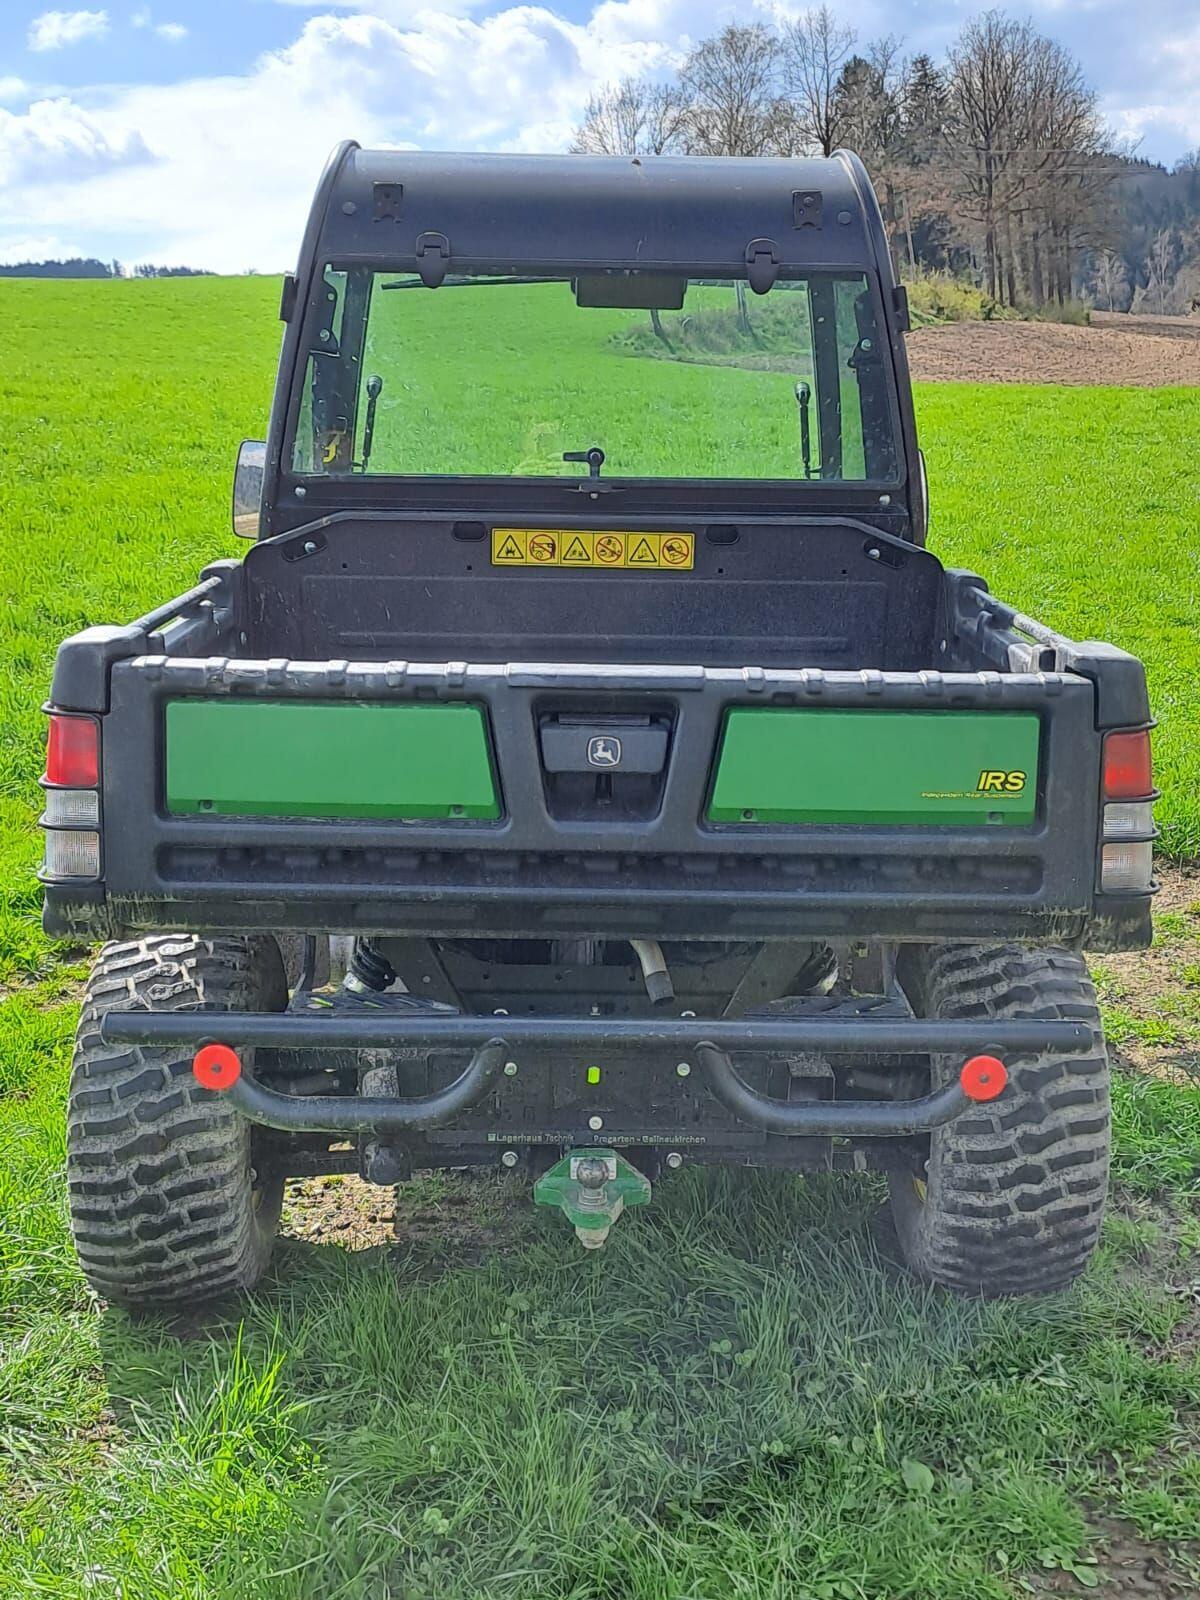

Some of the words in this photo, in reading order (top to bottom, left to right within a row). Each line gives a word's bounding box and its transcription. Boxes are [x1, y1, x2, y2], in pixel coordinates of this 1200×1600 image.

[977, 770, 1027, 791] IRS
[496, 1133, 542, 1144] Lagerhaus
[544, 1133, 574, 1144] Technik
